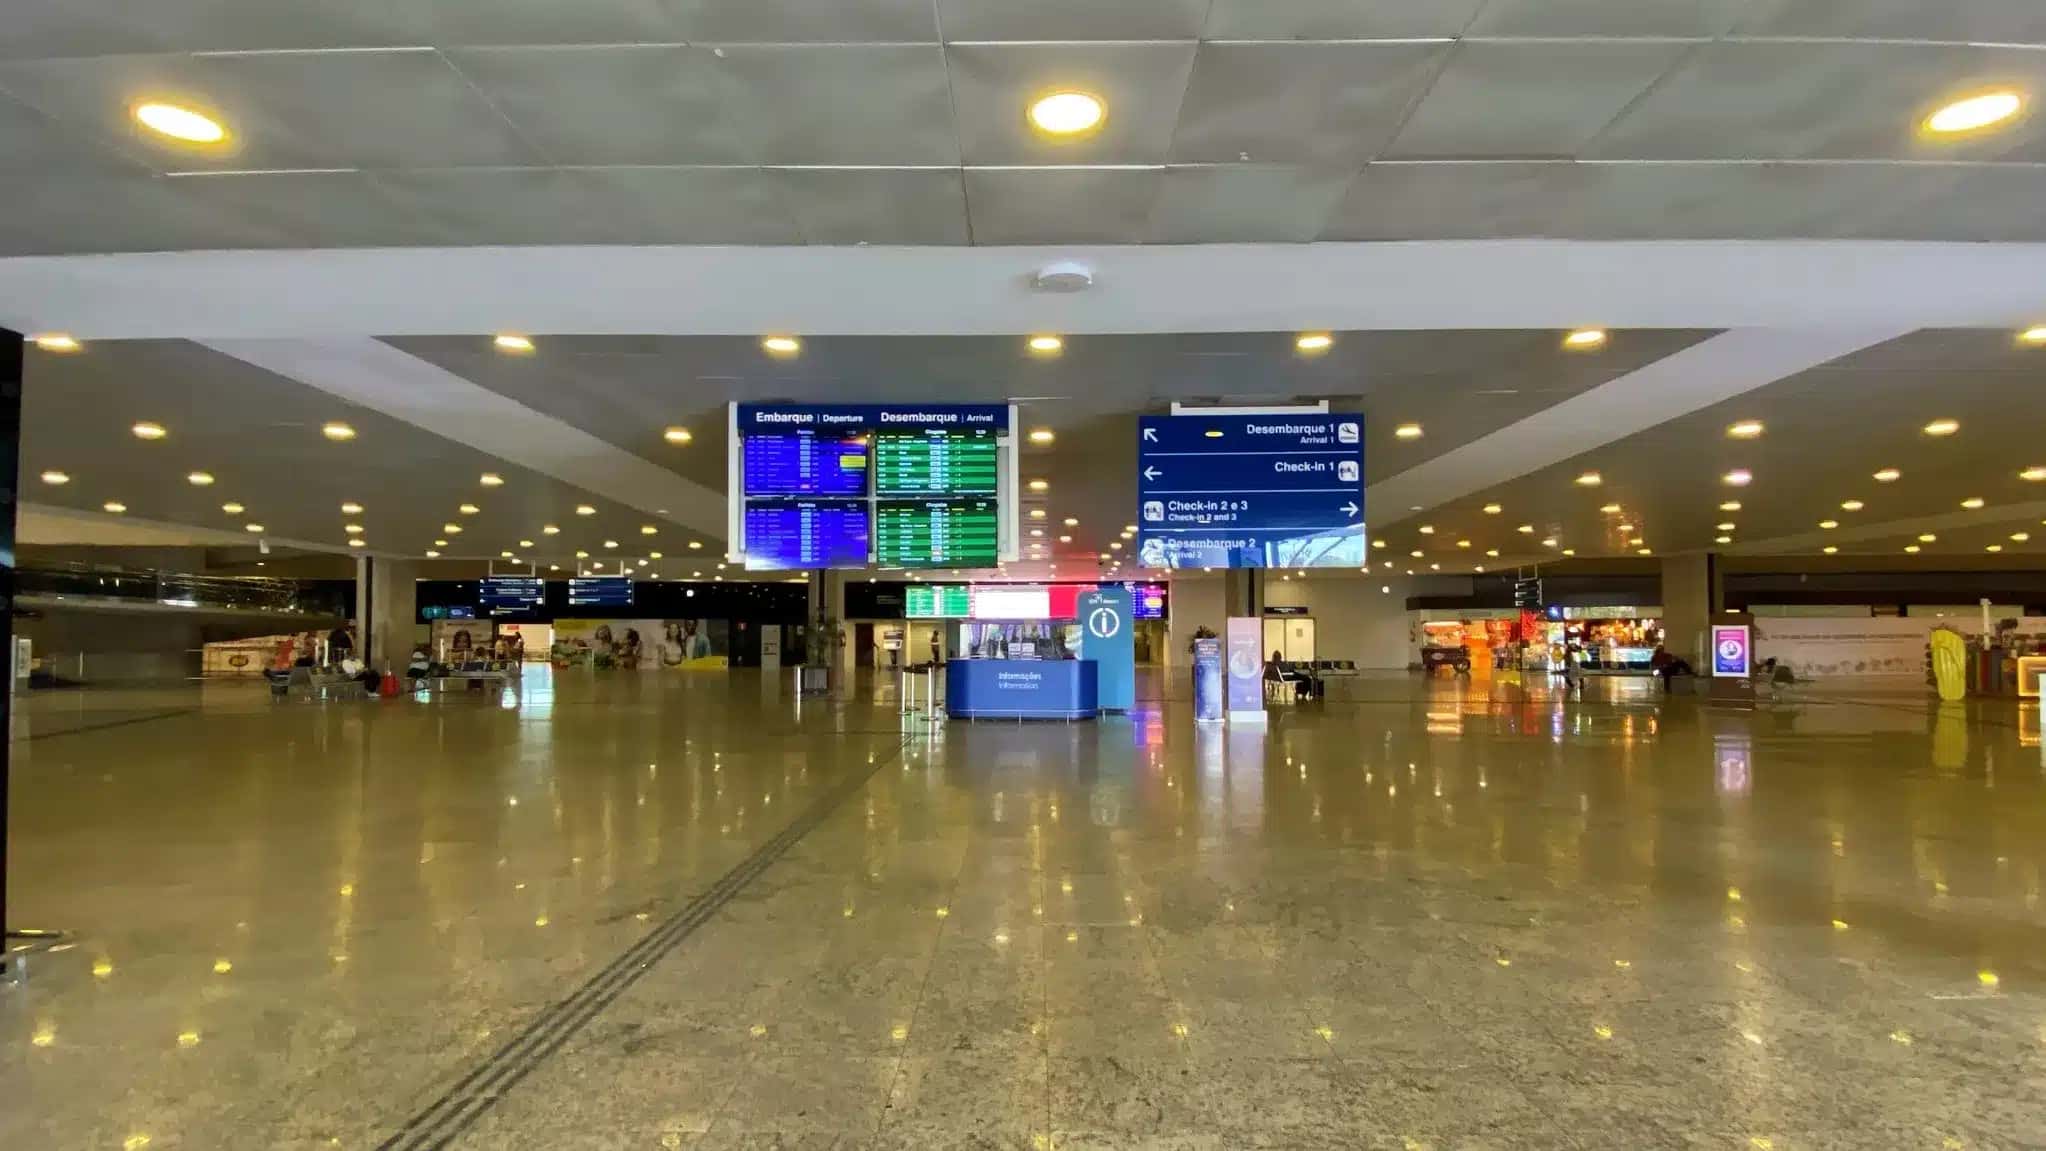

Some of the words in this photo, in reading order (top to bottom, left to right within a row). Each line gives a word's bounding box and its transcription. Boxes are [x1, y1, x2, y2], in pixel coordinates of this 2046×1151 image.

[755, 411, 814, 424] Embarque
[822, 414, 864, 423] Departure
[880, 411, 958, 424] Desembarque
[966, 413, 994, 422] Arrival
[1246, 423, 1326, 436] Desembarque
[1329, 423, 1334, 433] 1
[1300, 436, 1328, 444] Arrival
[1274, 461, 1326, 473] Check-in
[1329, 462, 1334, 471] 1
[1168, 500, 1218, 511] Check-in
[1221, 501, 1228, 510] 2
[1241, 501, 1248, 510] 3
[1168, 512, 1204, 521] Check-in
[1168, 538, 1246, 550] Desembarque
[1248, 538, 1256, 548] 2
[1168, 550, 1195, 558] Arrival
